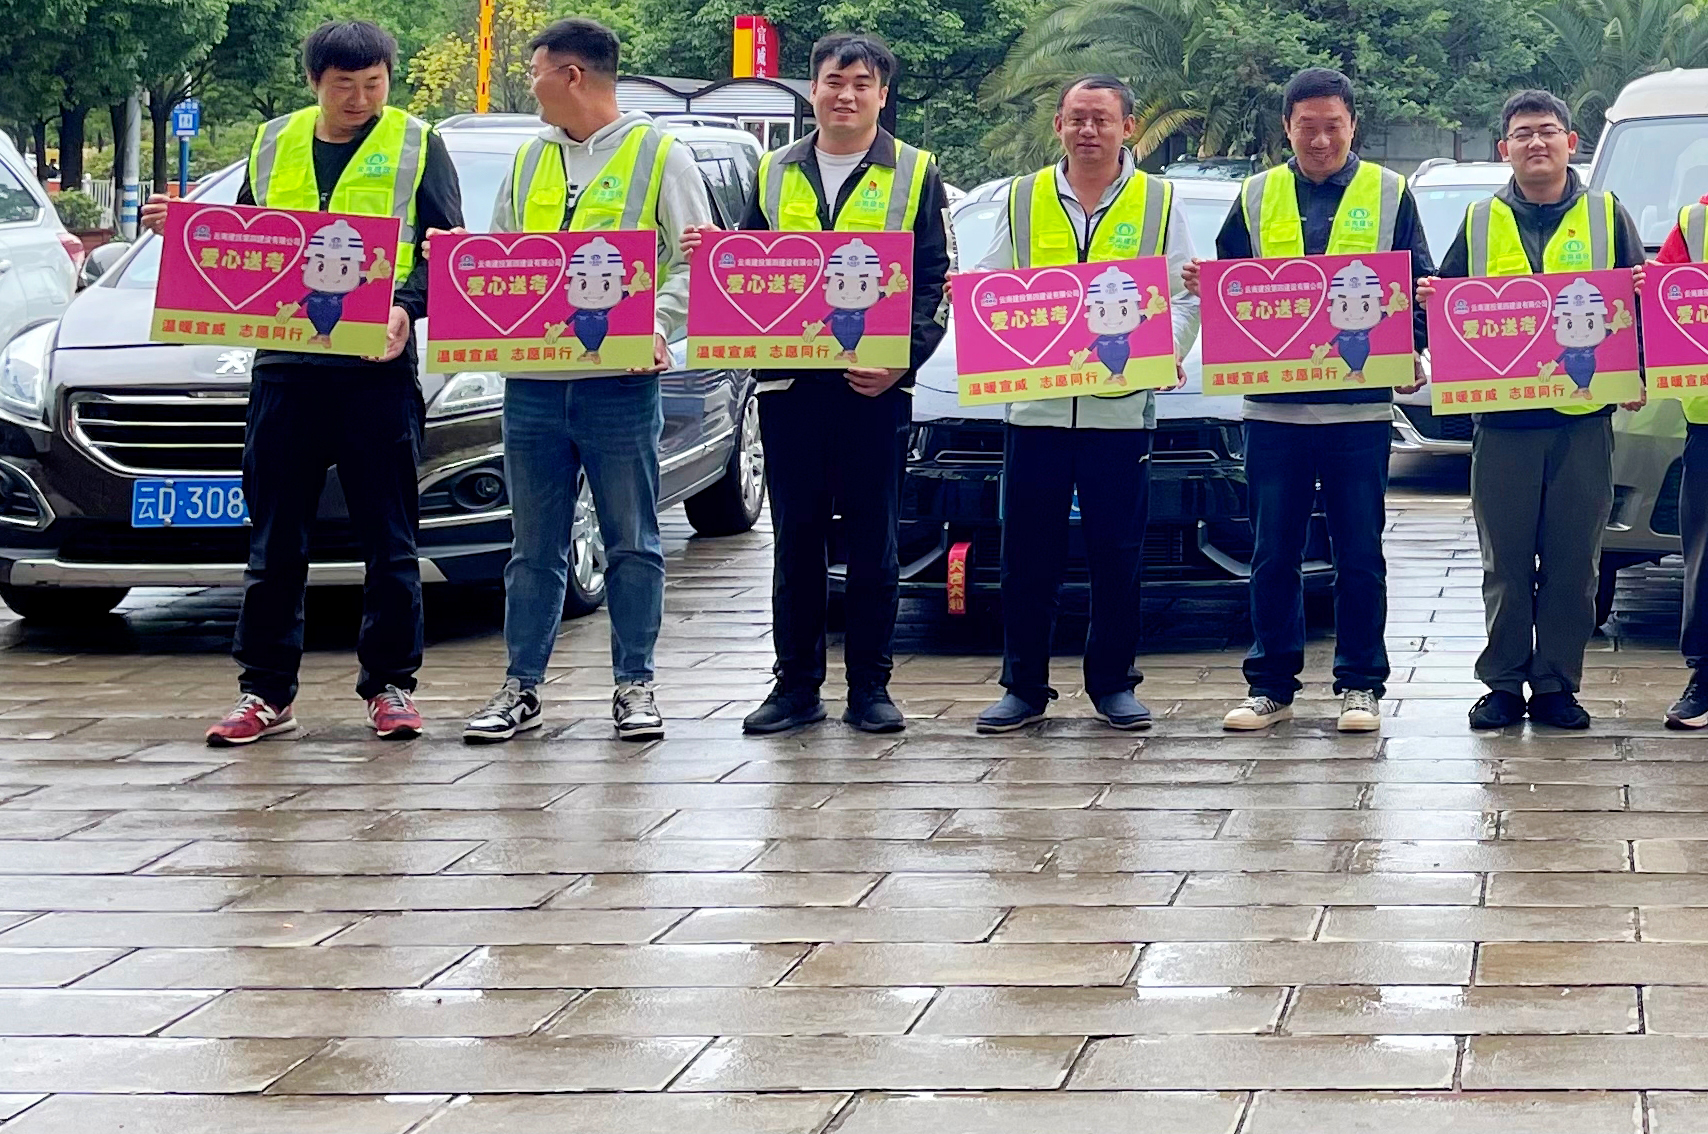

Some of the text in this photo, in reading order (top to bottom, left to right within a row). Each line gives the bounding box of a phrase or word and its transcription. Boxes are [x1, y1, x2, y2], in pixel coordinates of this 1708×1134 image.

[199, 247, 286, 273] 爱心送考
[467, 275, 548, 297] 爱心送考
[726, 274, 807, 295] 爱心送考
[990, 305, 1069, 331] 爱心送考
[1235, 297, 1312, 321] 爱心送考
[162, 319, 303, 341] 温暖宣威 志愿同行
[1462, 315, 1537, 339] 爱心送考
[437, 346, 572, 363] 温暖宣威 志愿同行
[696, 345, 831, 359] 温暖宣威 志愿同行
[968, 371, 1098, 396] 温暖宣威 志愿同行
[1212, 366, 1338, 387] 温暖宣威 志愿同行
[1441, 383, 1566, 405] 温暖宣威 志愿同行
[949, 558, 964, 610] 大吉大利
